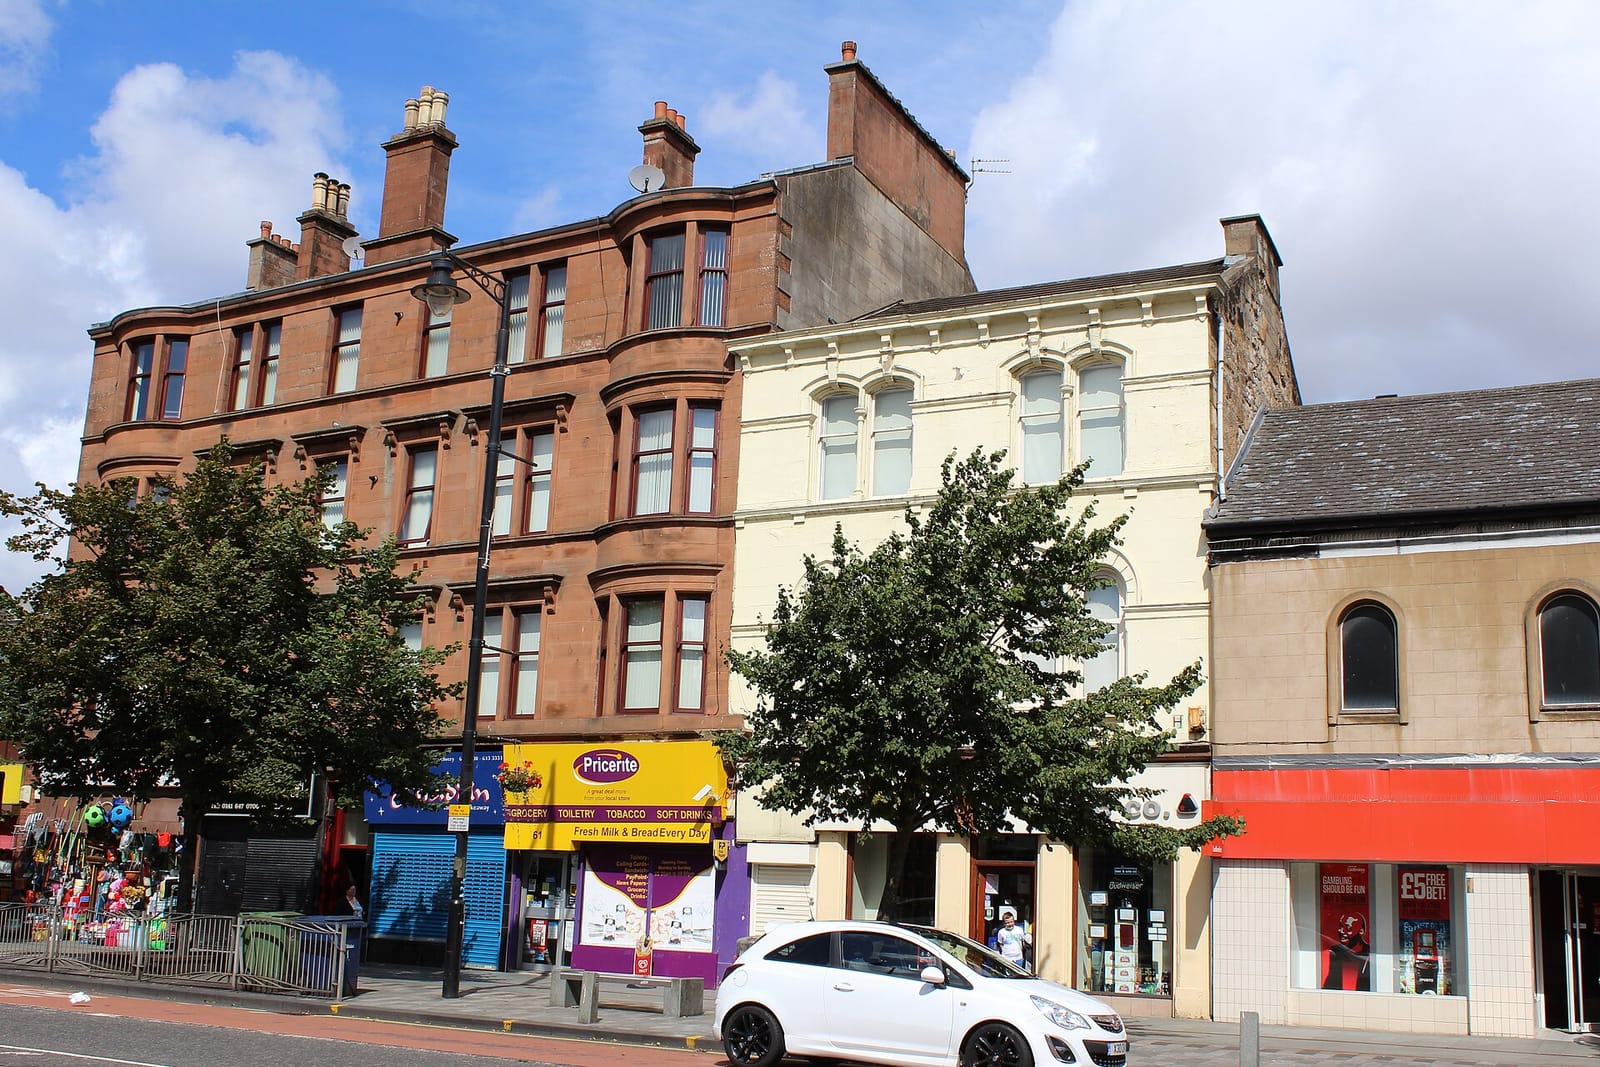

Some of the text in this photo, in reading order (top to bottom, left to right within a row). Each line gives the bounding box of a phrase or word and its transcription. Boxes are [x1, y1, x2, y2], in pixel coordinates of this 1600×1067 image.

[583, 756, 639, 773] Pricerite
[511, 809, 713, 820] GROCERY TOILETRY TOBACCO SOFT DRINKS
[532, 831, 542, 840] 61
[574, 826, 708, 840] Fresh Milk & Bread Every Day
[1322, 876, 1352, 885] GAMBLING
[1401, 872, 1446, 900] £5 FREE
[627, 886, 647, 894] Grocery
[1322, 885, 1366, 894] SHOULD BE FUN
[1426, 886, 1447, 900] BET!
